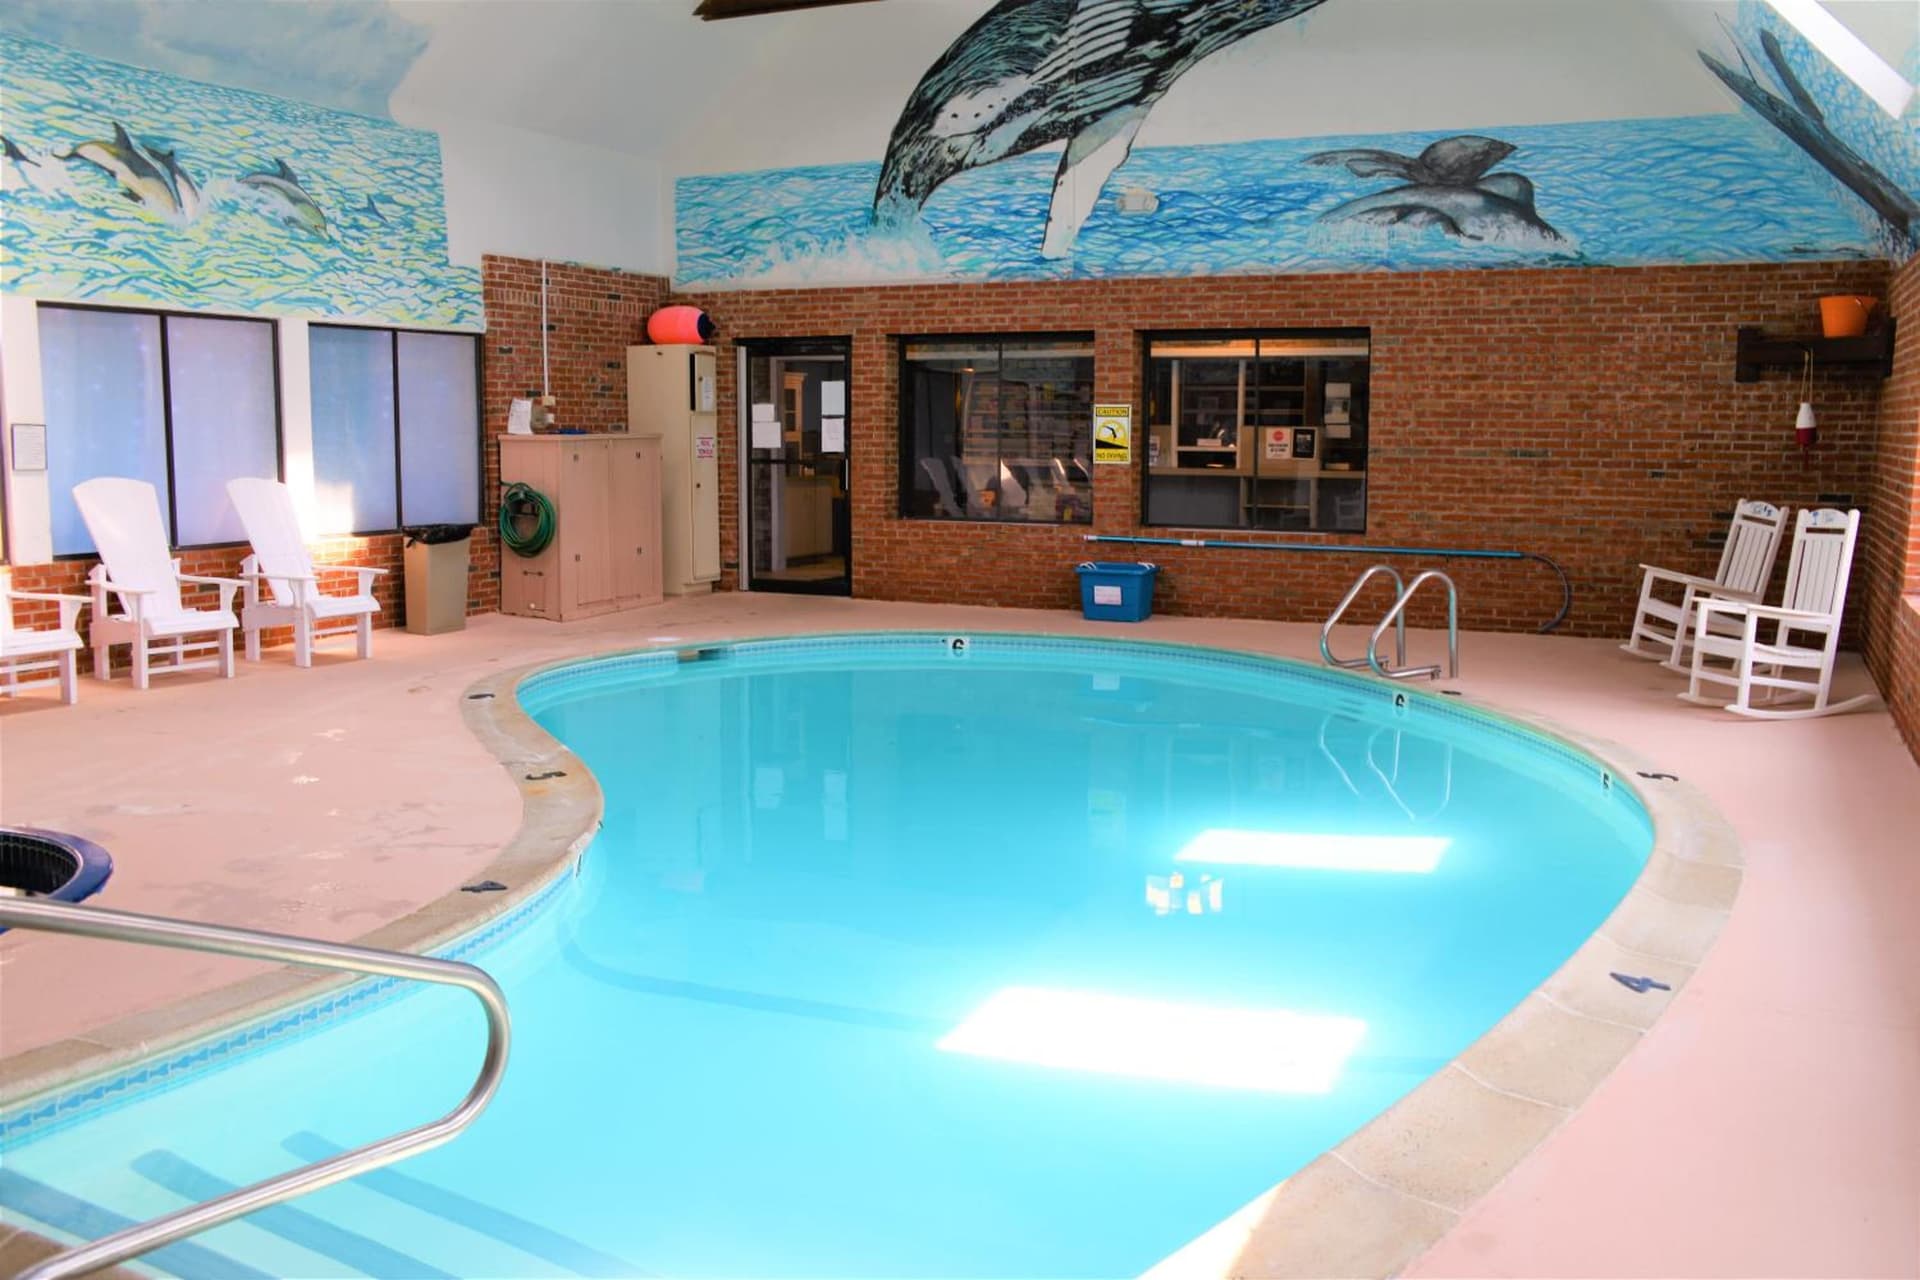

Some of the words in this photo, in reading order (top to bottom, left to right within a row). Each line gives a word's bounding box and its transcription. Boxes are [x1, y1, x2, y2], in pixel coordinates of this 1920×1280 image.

[1097, 407, 1128, 416] CAUTION
[1096, 453, 1106, 461] NO
[1107, 453, 1128, 461] DIVING
[1609, 972, 1672, 994] 4
